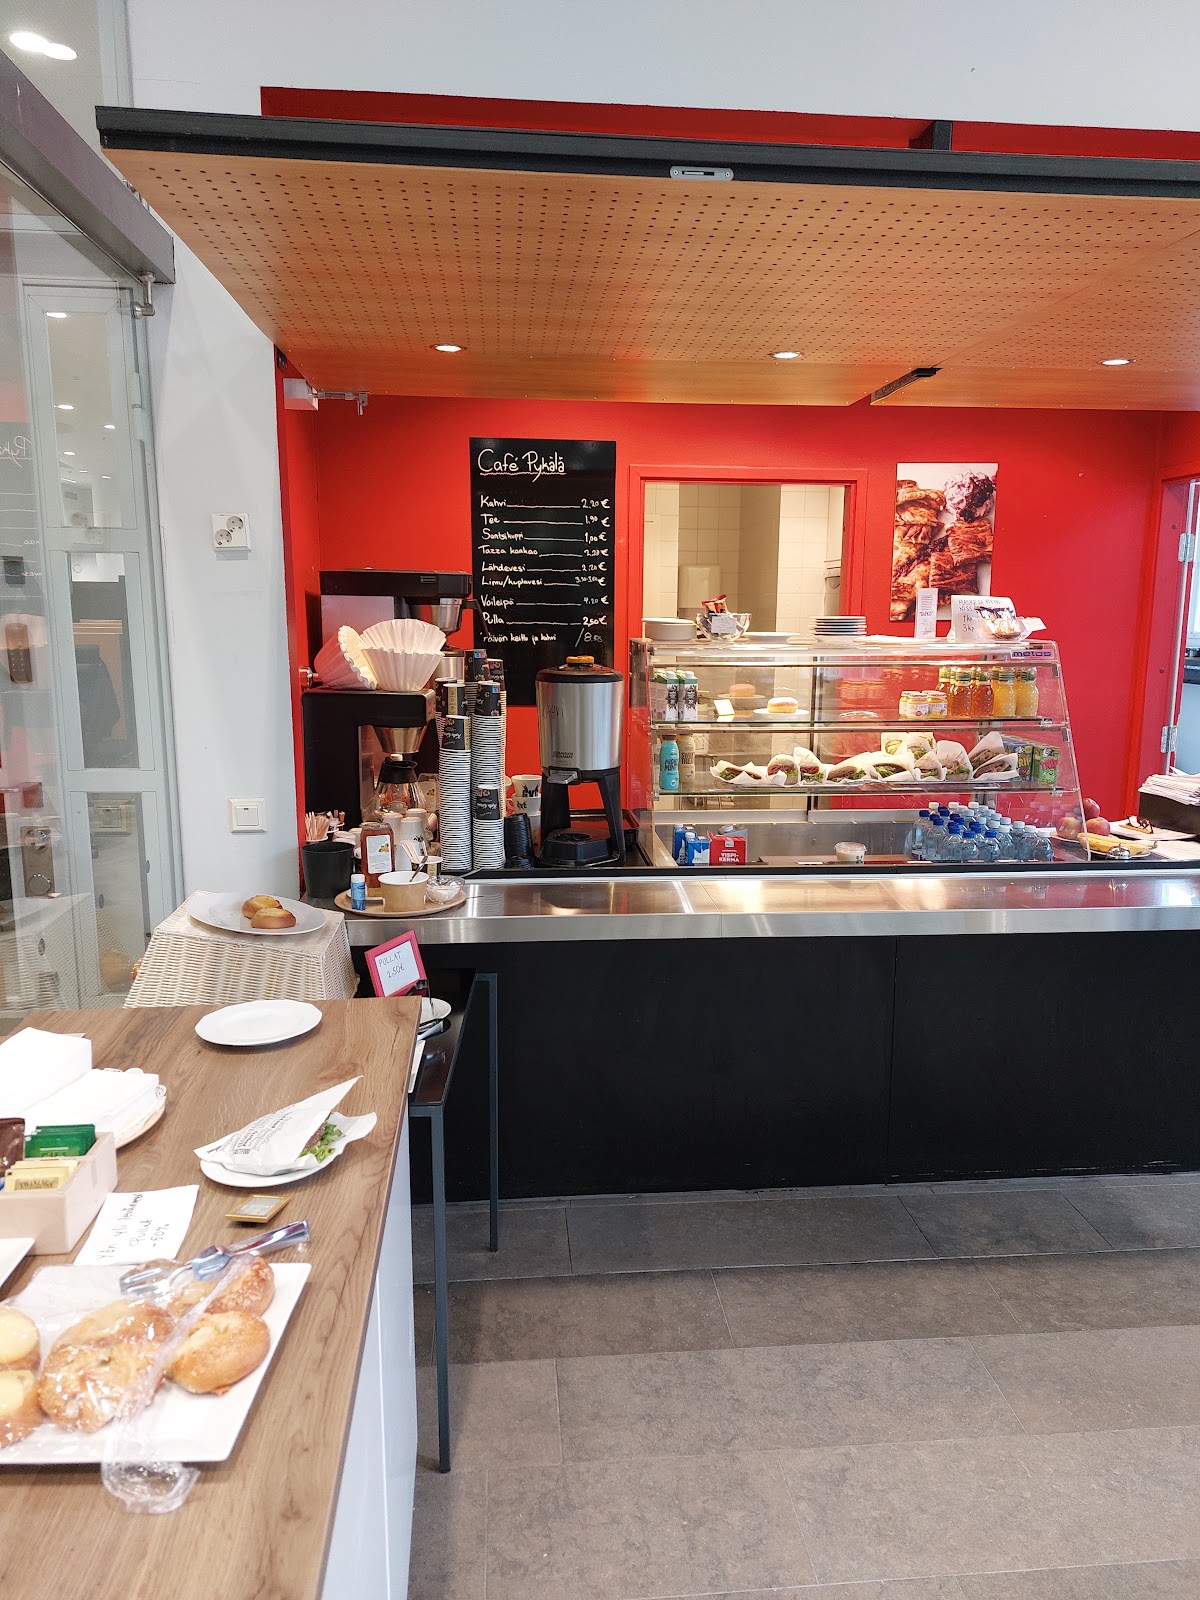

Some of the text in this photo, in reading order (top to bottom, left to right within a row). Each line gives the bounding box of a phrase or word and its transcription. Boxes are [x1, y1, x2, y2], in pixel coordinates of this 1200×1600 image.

[477, 448, 566, 483] Café Pykälä
[480, 494, 507, 508] Kahvi
[480, 513, 501, 525] Tee
[477, 544, 507, 555] Tazza
[509, 546, 539, 555] kaakao
[481, 560, 526, 572] Lähdevesi
[480, 594, 515, 609] Voileipä
[482, 611, 504, 625] Pulla
[1018, 756, 1031, 768] RIP
[378, 950, 401, 968] PULLAT
